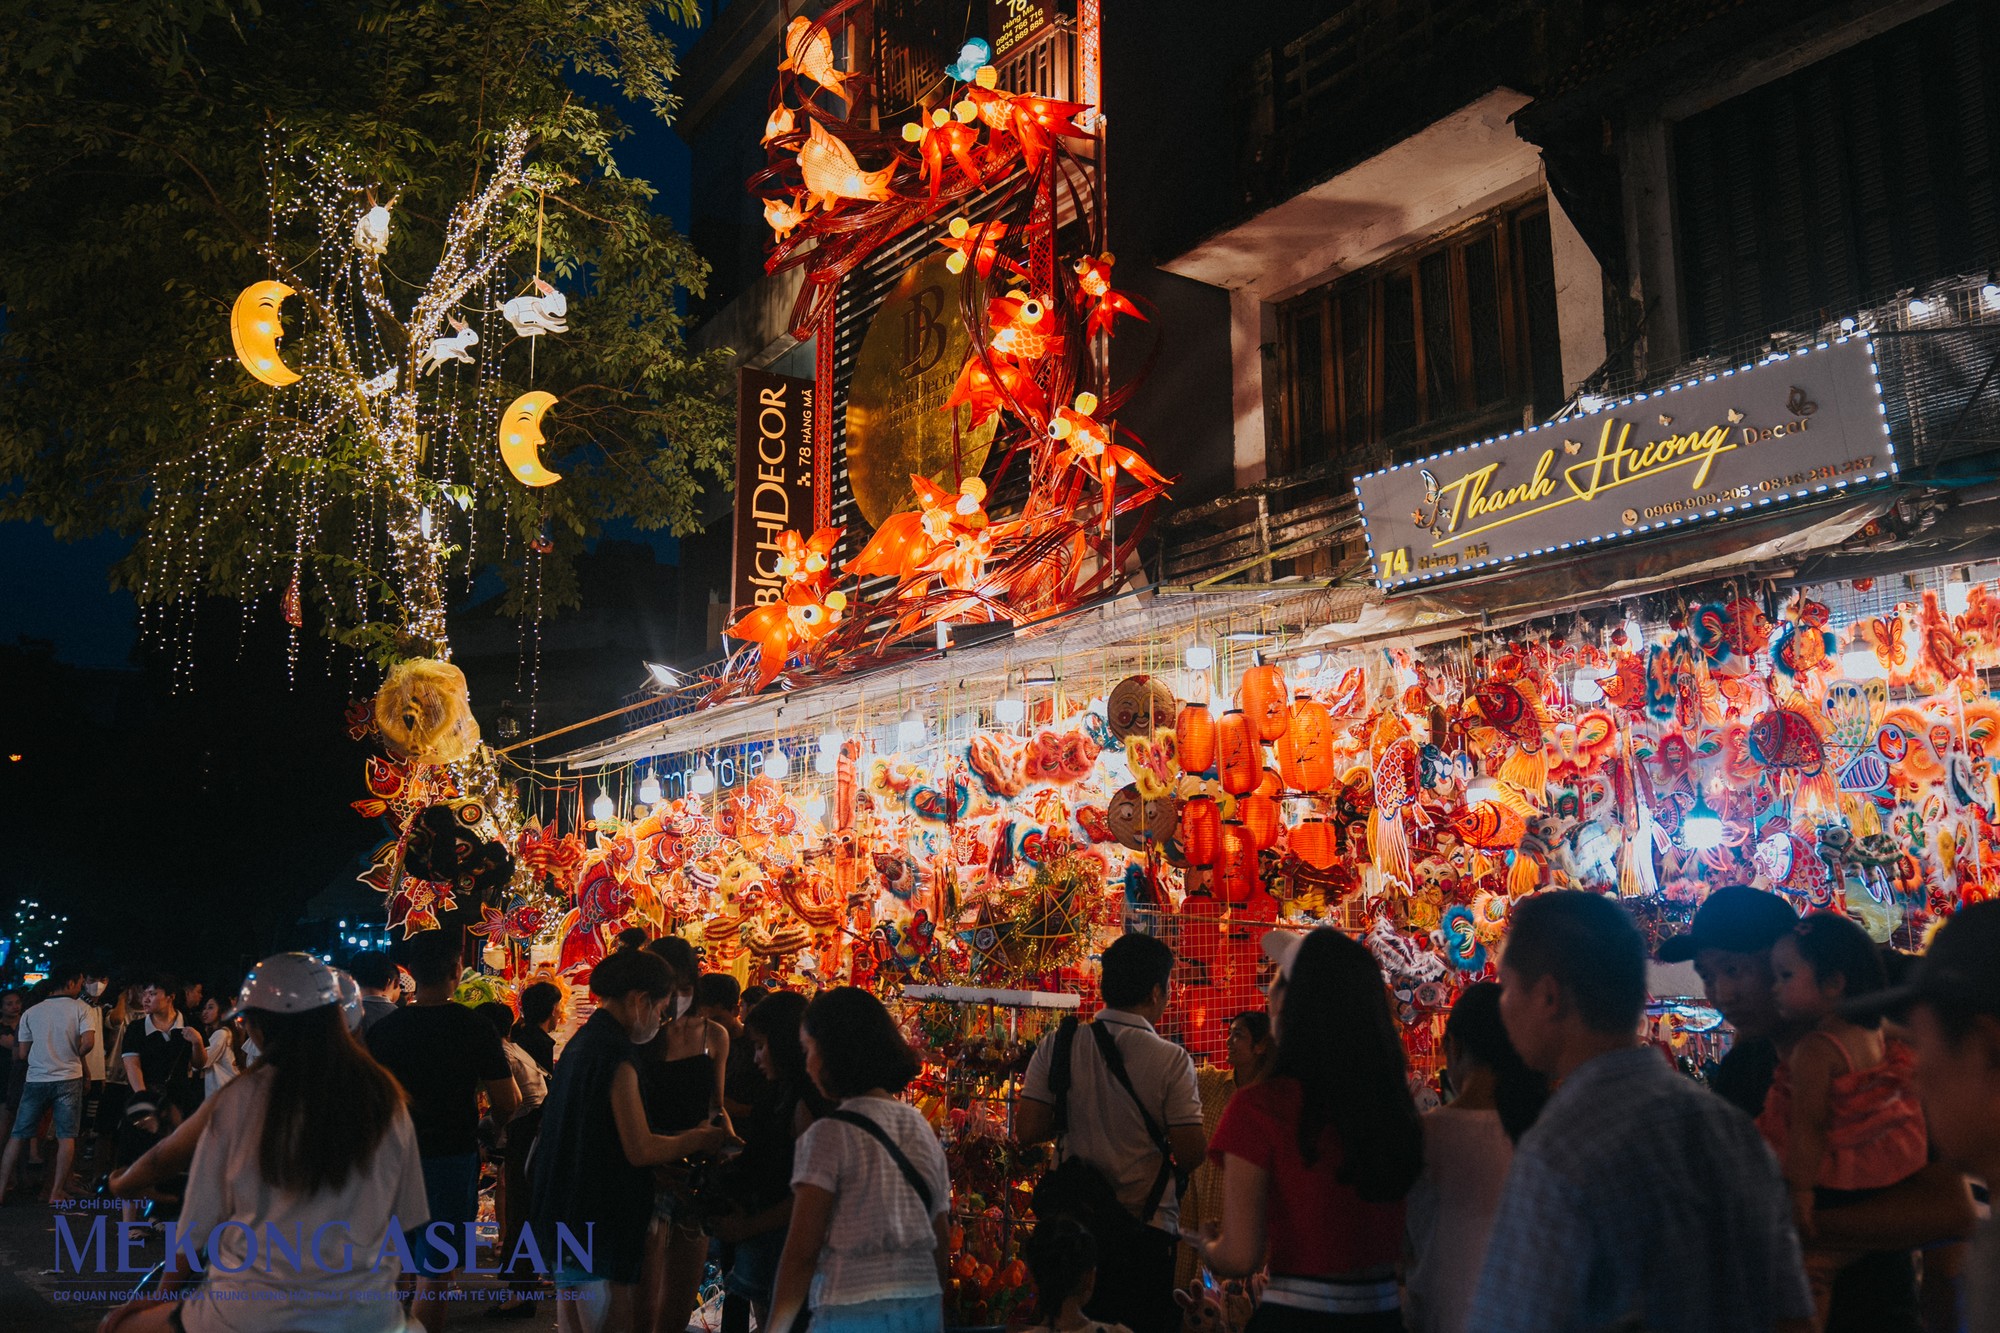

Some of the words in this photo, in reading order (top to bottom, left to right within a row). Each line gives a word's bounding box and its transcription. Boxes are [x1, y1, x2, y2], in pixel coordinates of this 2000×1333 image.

[996, 30, 1013, 46] 0904
[1014, 19, 1028, 33] 766
[1029, 8, 1044, 22] 716
[996, 38, 1014, 55] 0333
[800, 388, 813, 408] MÃ
[799, 410, 813, 444] HÀNG
[1742, 417, 1810, 446] Decor
[798, 446, 812, 467] 78
[1438, 447, 1559, 534] Thanh
[1563, 418, 1733, 501] Hương
[1380, 548, 1409, 579] 74
